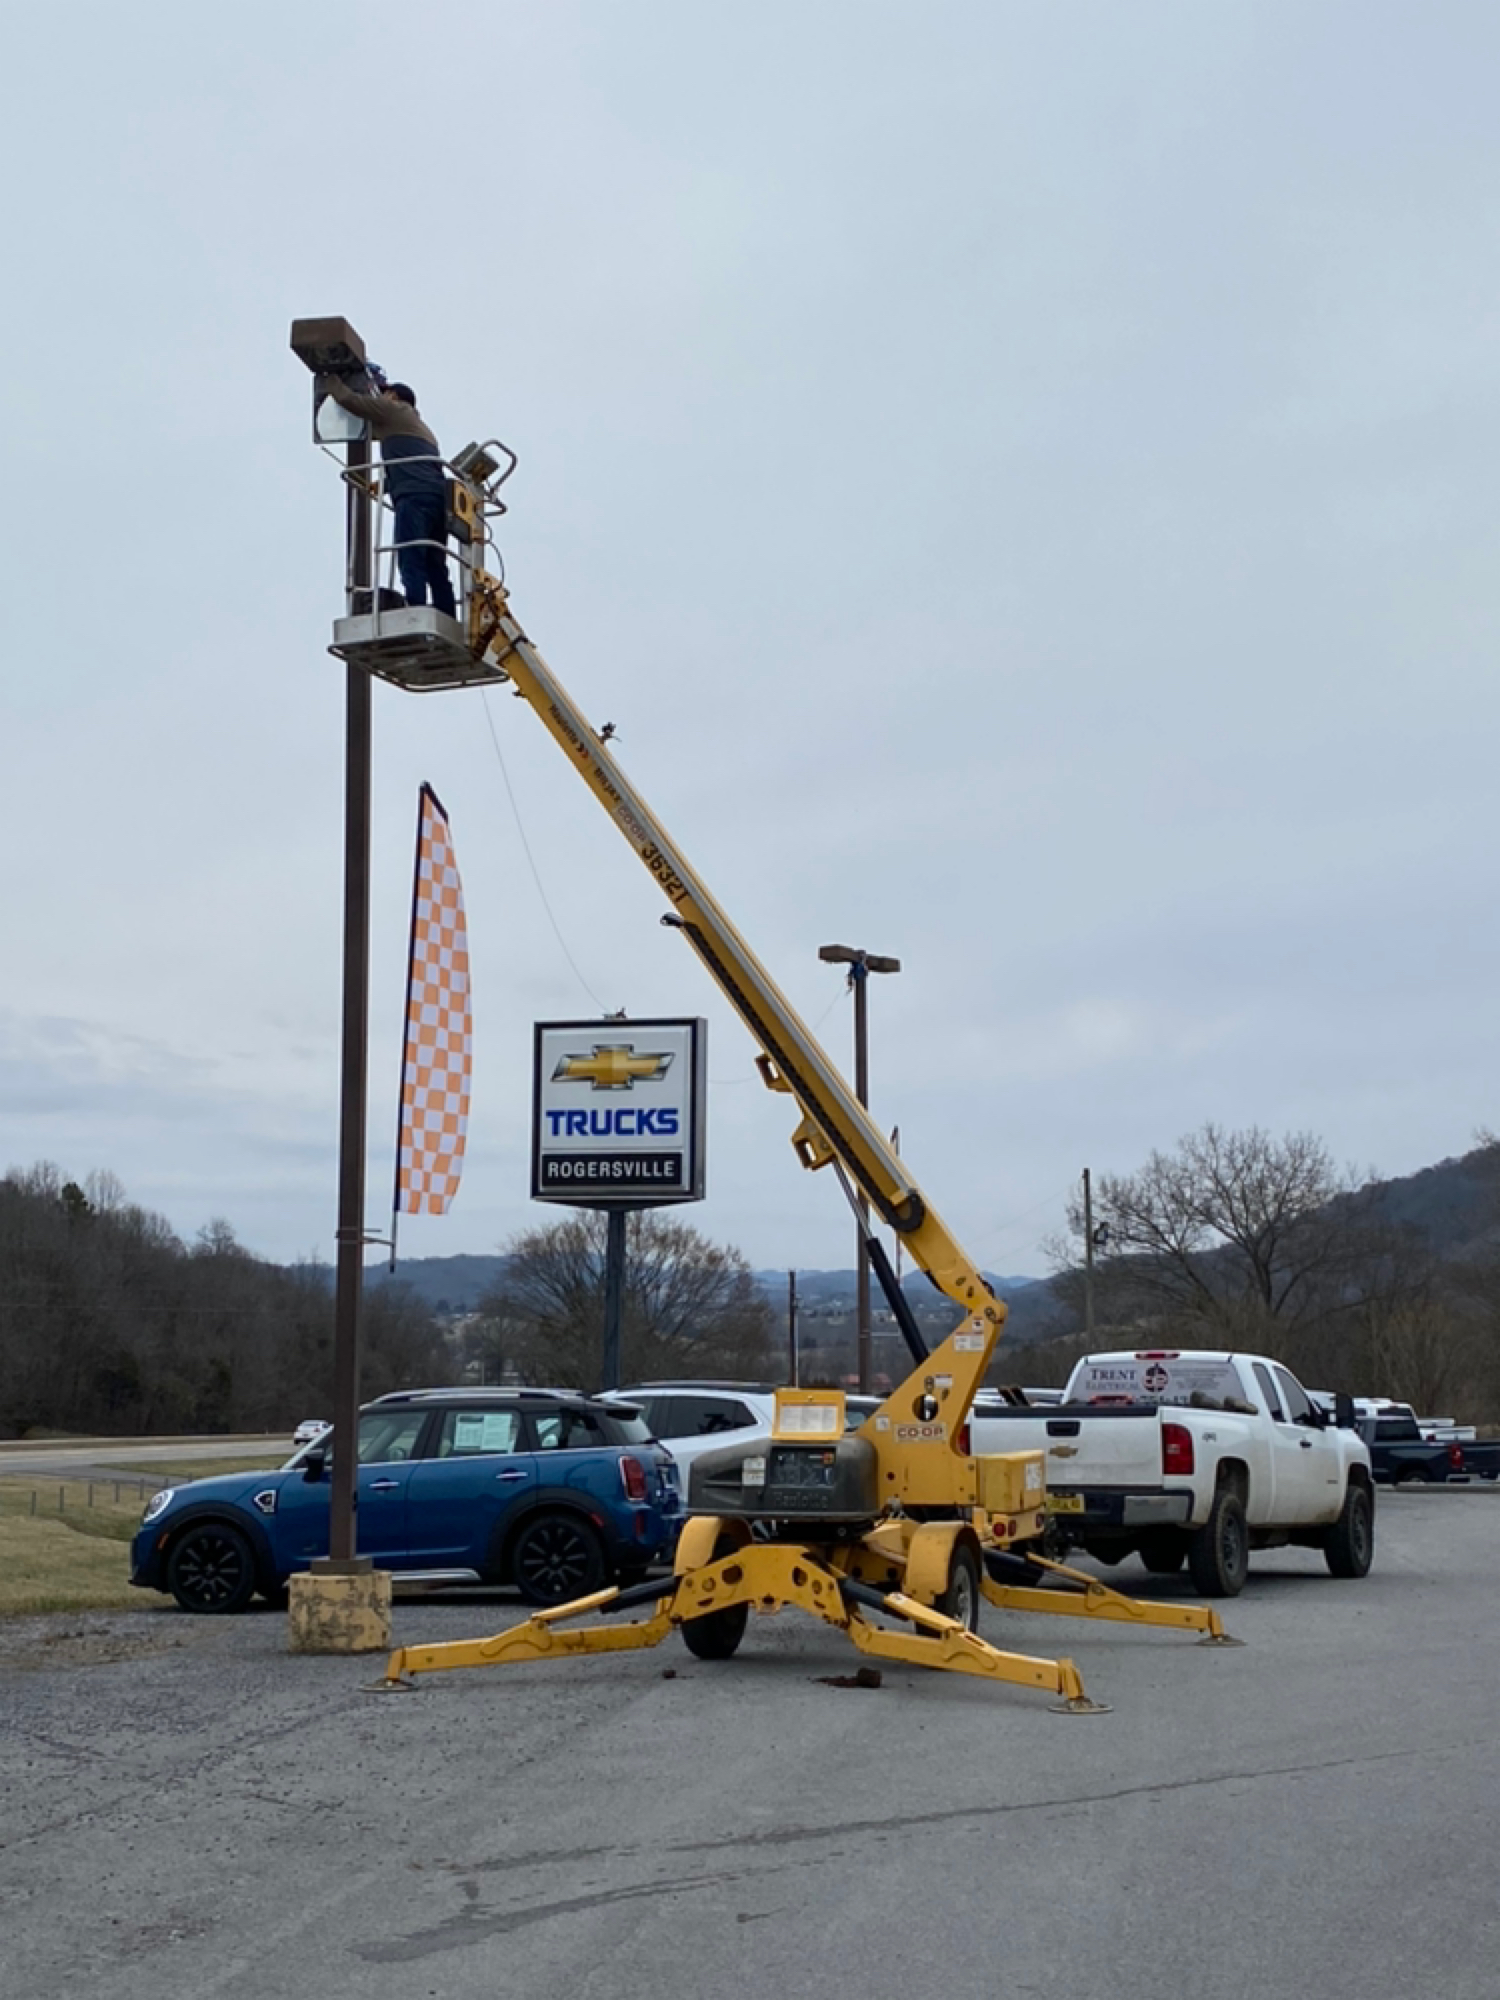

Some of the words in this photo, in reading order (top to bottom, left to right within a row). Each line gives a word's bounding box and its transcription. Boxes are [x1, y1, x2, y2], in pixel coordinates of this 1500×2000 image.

[642, 841, 690, 904] 36321
[545, 1108, 679, 1137] TRUCKS
[547, 1160, 676, 1179] ROGERSVILLE
[1090, 1367, 1138, 1381] TRENT
